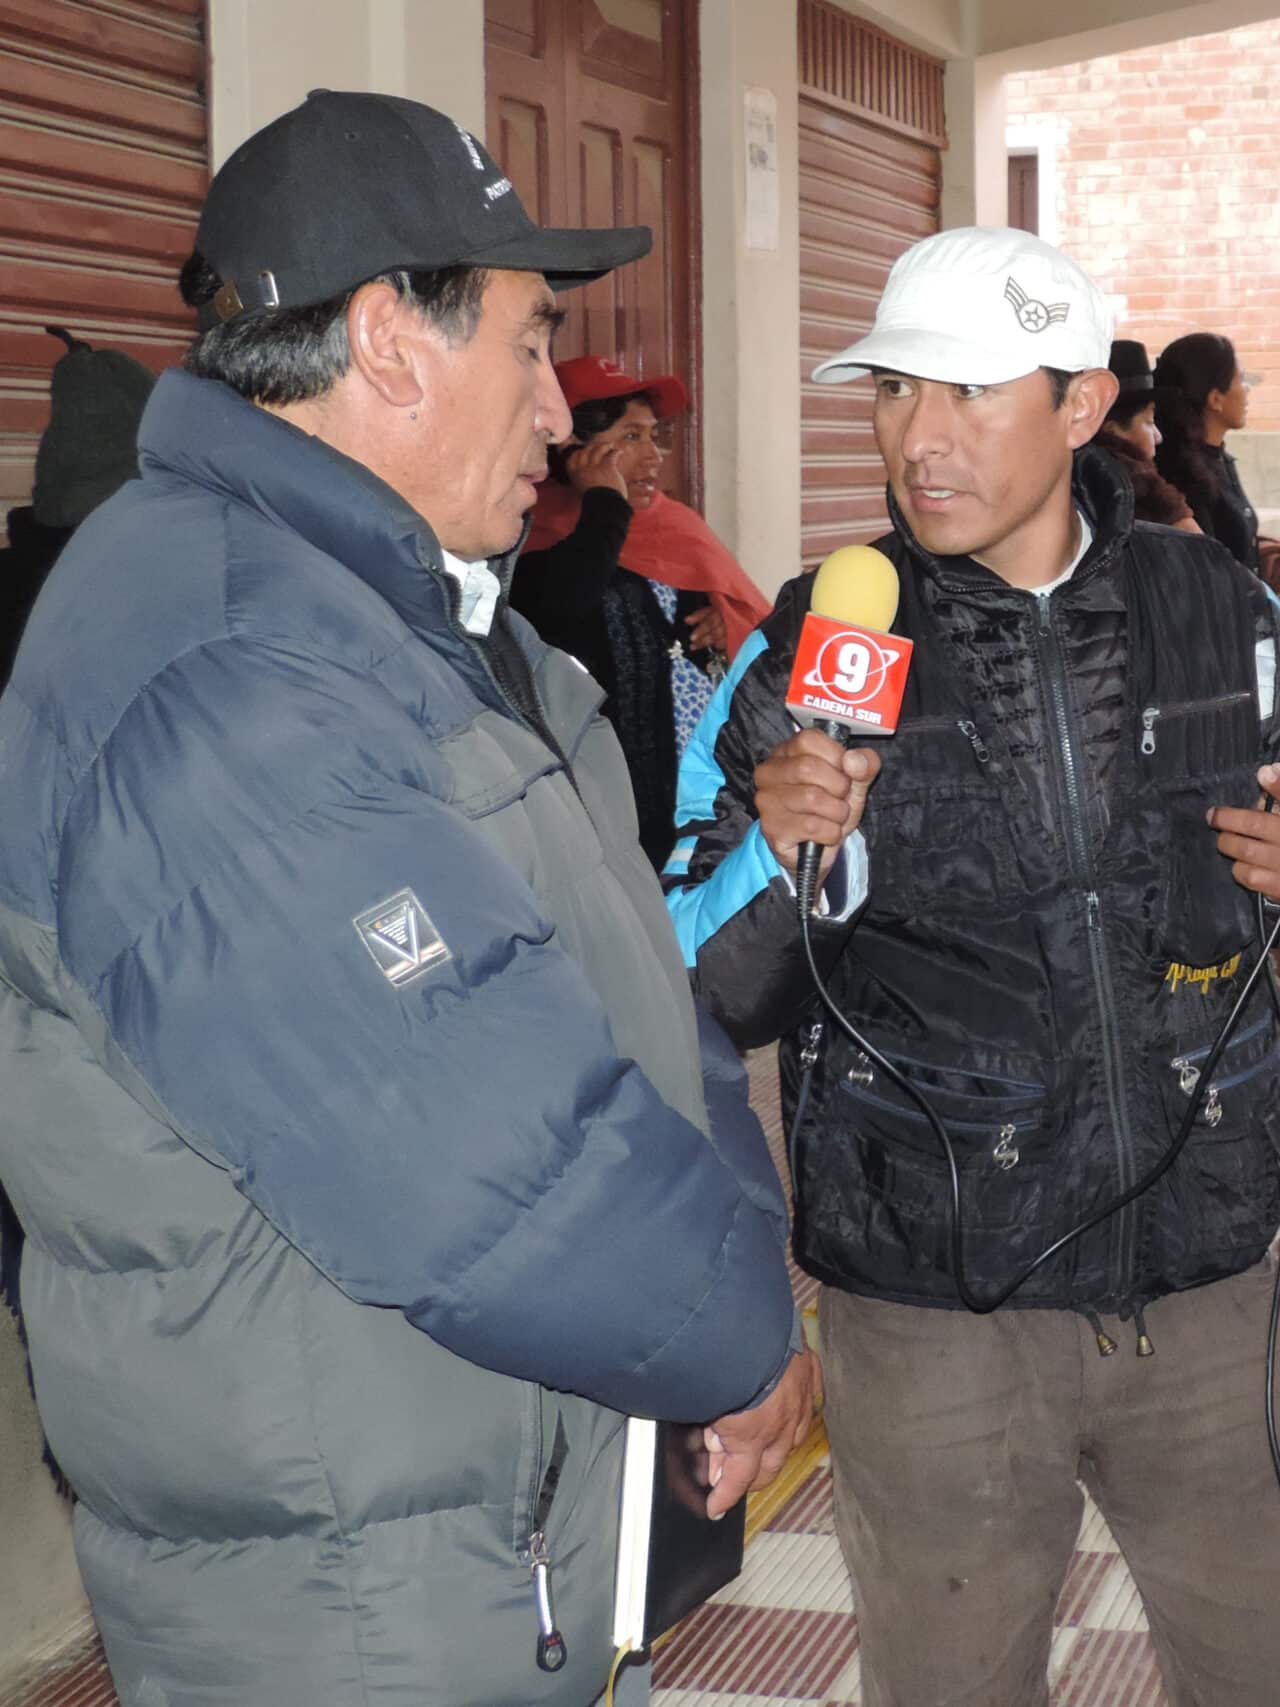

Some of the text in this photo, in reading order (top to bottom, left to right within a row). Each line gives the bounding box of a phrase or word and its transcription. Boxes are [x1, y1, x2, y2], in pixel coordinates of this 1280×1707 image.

[833, 642, 871, 694] 9
[803, 693, 882, 725] CADENA SUR
